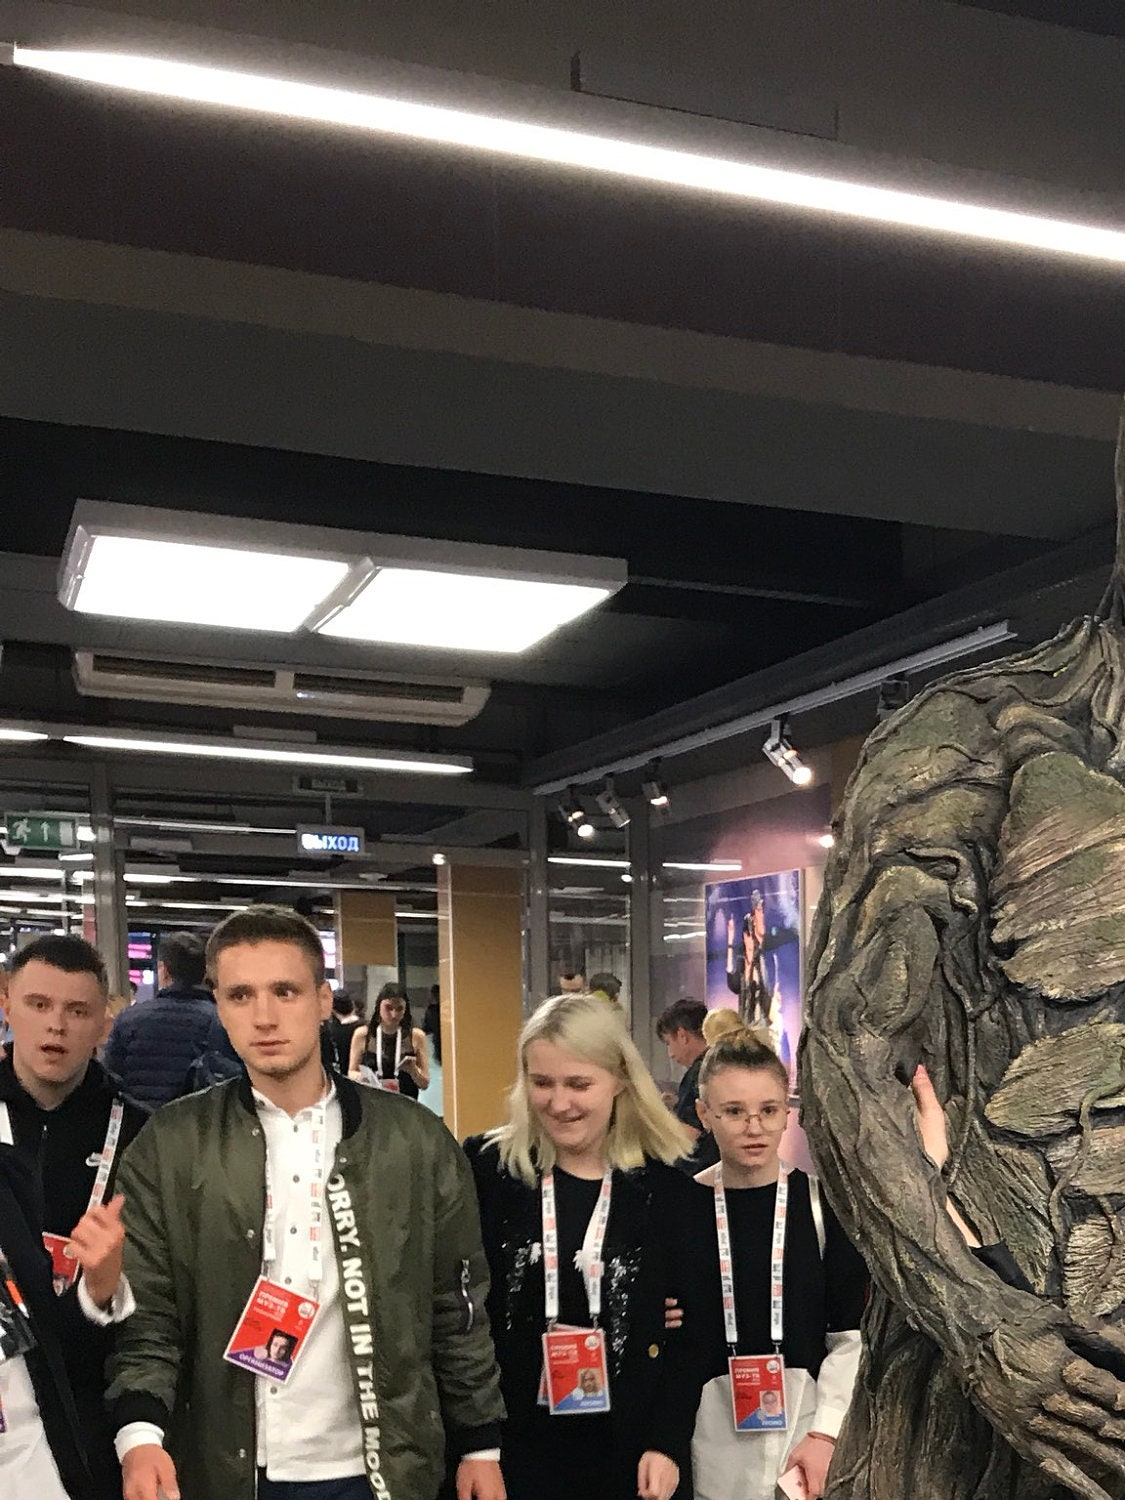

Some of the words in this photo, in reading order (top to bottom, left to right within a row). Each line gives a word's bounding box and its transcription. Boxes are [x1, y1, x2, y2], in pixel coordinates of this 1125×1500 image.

[302, 833, 359, 852] ЫХОД
[327, 1173, 360, 1252] ORRY.
[342, 1257, 369, 1316] NOT
[350, 1323, 373, 1356] IN
[357, 1361, 380, 1420] THE
